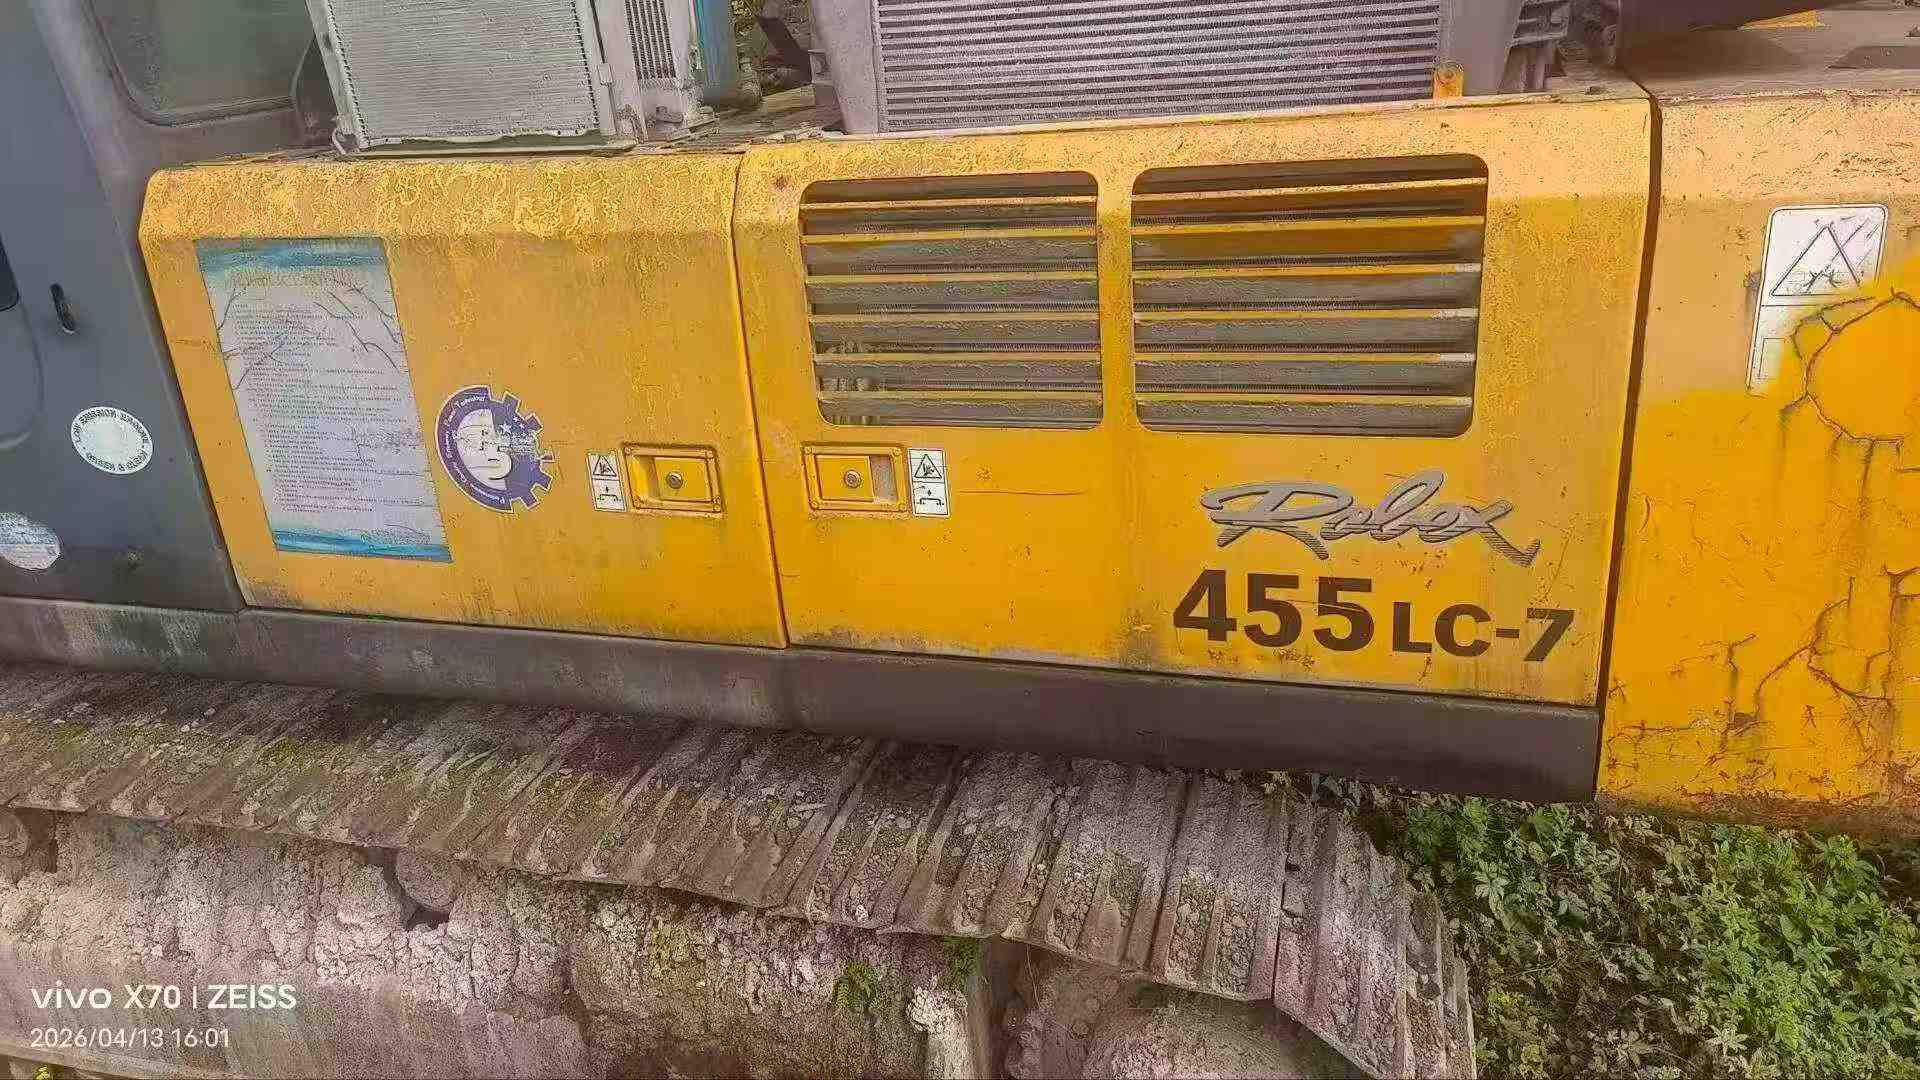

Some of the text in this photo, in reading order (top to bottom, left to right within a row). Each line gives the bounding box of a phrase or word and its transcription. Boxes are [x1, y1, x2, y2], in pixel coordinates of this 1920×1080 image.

[1200, 468, 1541, 568] Robex
[1173, 568, 1575, 663] 455 LC-7
